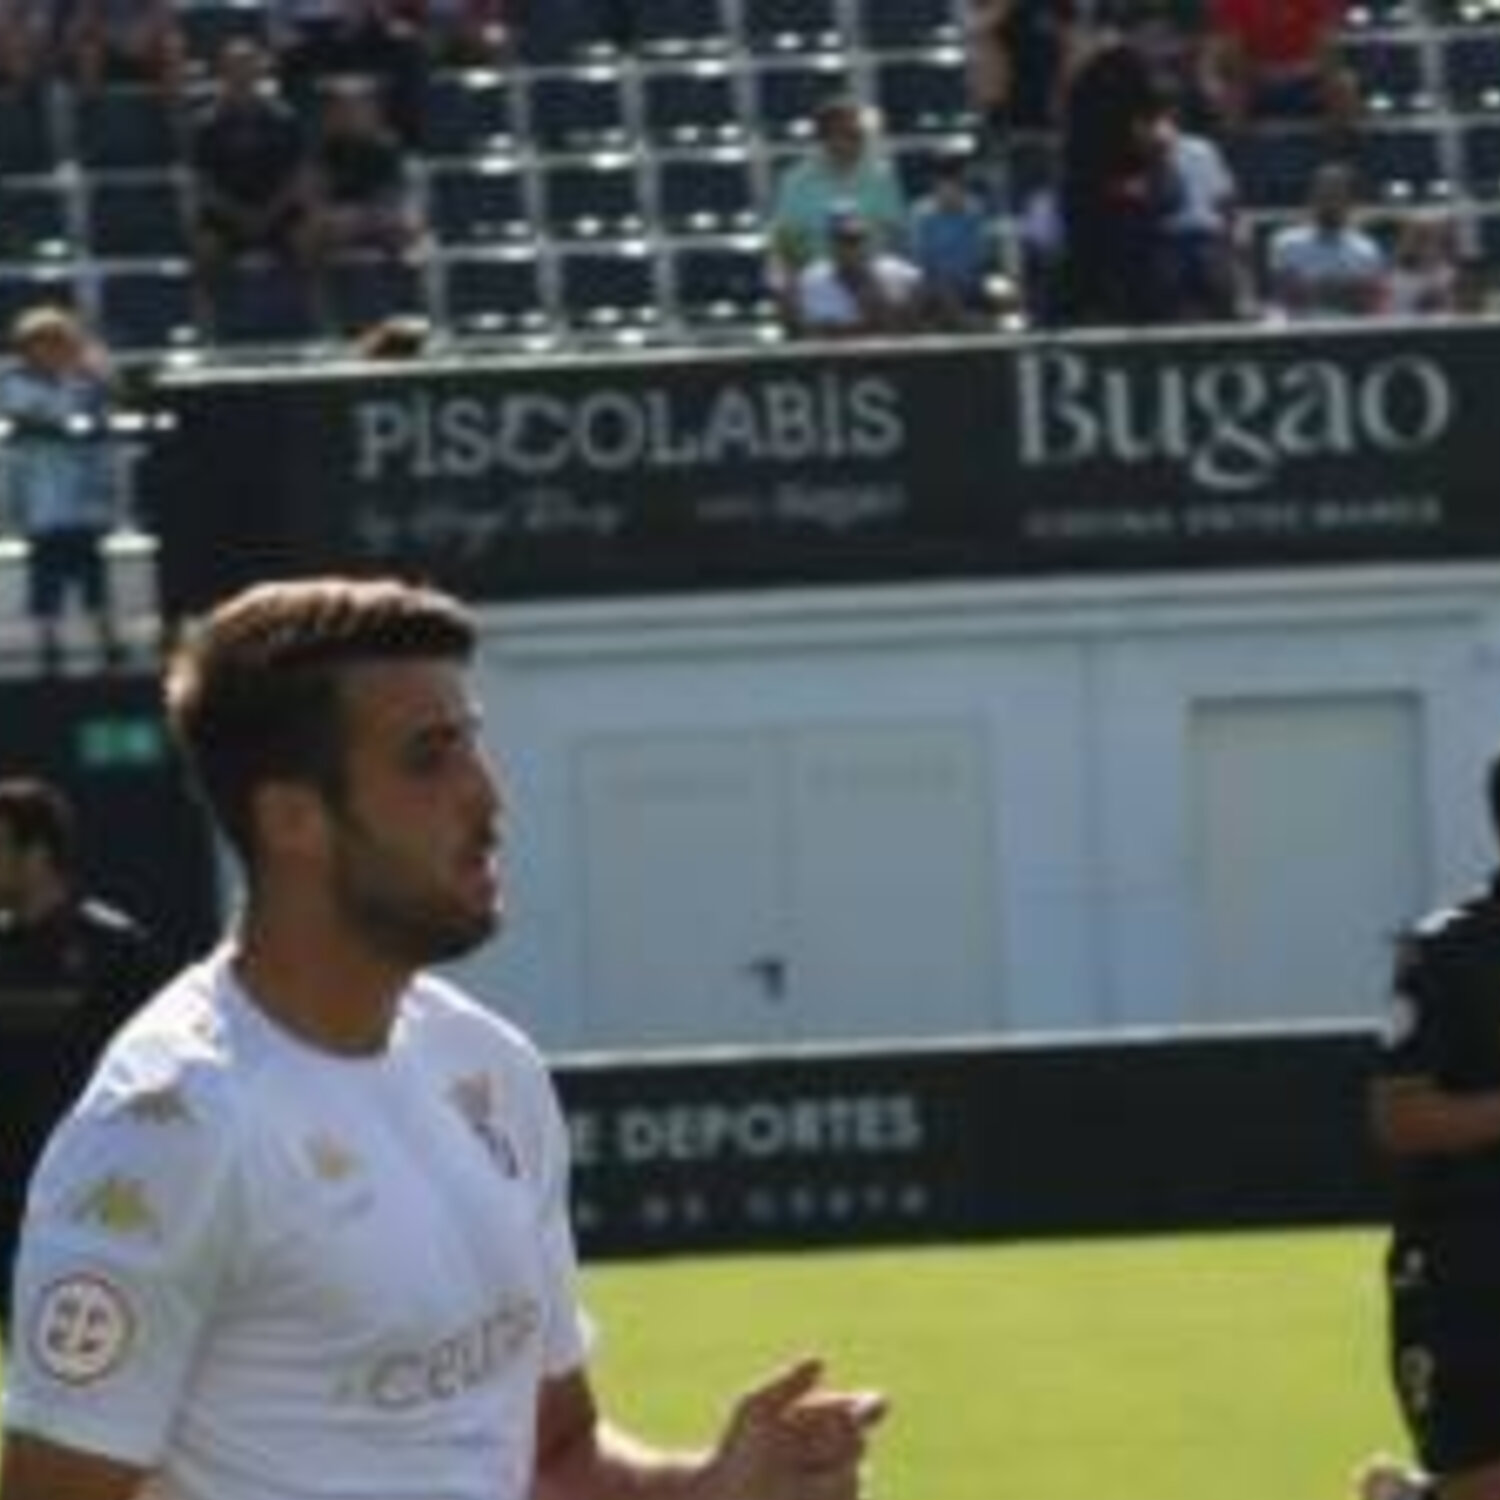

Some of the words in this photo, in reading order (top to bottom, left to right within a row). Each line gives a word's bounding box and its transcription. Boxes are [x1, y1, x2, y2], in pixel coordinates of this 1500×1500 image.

[355, 372, 904, 478] PISCOLABIS
[1016, 347, 1454, 490] Bugao
[616, 1096, 923, 1160] DEPORTES
